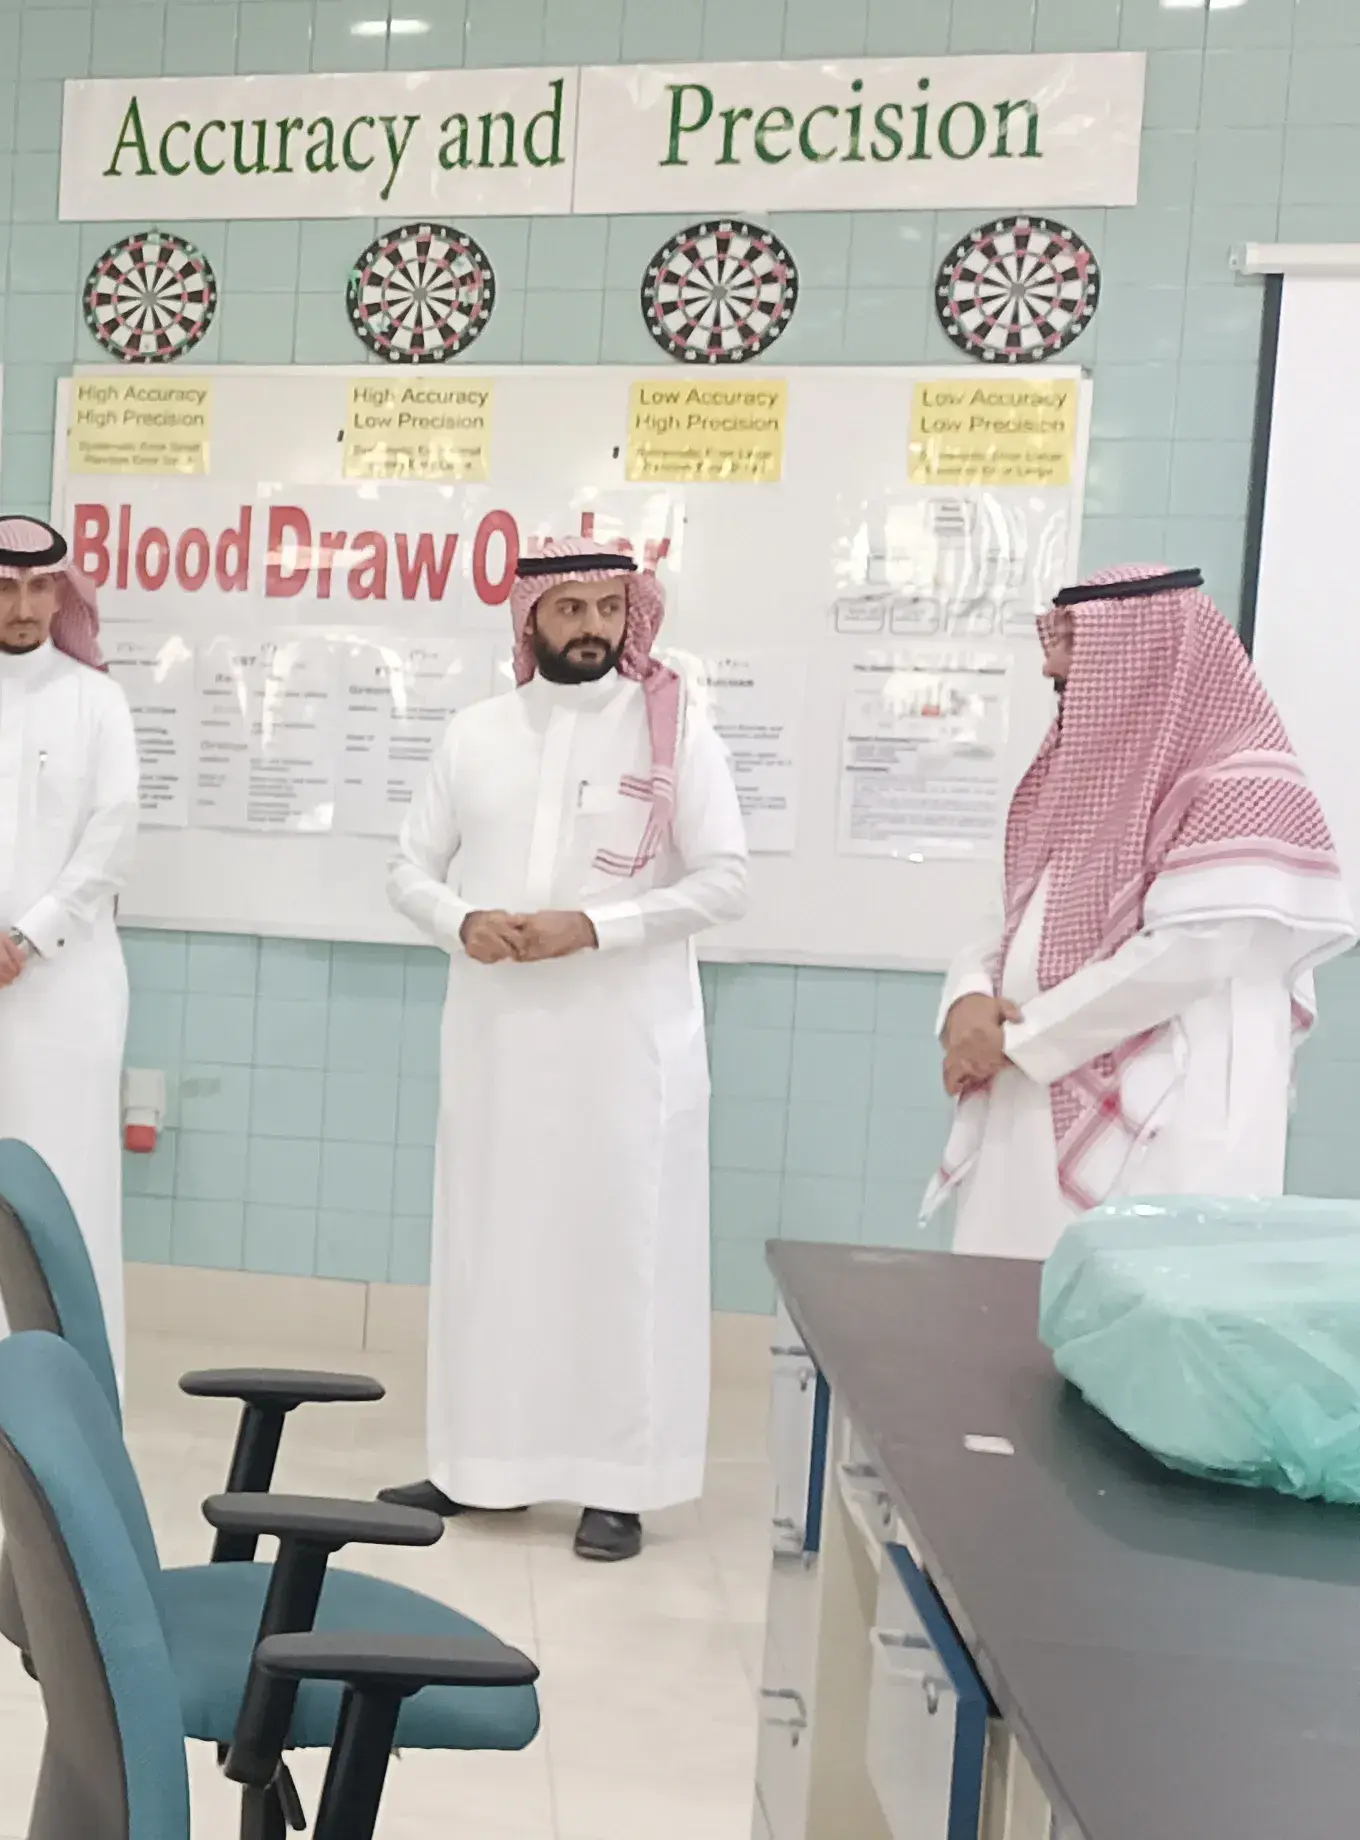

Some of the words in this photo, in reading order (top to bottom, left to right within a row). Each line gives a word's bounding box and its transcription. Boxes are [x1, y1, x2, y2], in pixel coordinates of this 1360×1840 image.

[102, 95, 421, 200] Accuracy
[438, 78, 566, 168] and
[659, 77, 1044, 167] Precision
[78, 384, 118, 405] High
[124, 384, 208, 406] Accuracy
[353, 387, 396, 408] High
[401, 388, 489, 408] Accuracy
[640, 388, 680, 406] Low
[685, 388, 779, 408] Accuracy
[922, 388, 965, 407] Low
[969, 388, 1067, 411] Accuracy
[77, 408, 117, 428] High
[123, 408, 204, 427] Precision
[354, 412, 392, 429] Low
[398, 412, 484, 430] Precision
[635, 413, 680, 435] High
[686, 413, 779, 432] Precision
[920, 415, 962, 433] Low
[969, 415, 1065, 434] Precision
[73, 503, 253, 593] Blood
[264, 505, 459, 602] Draw
